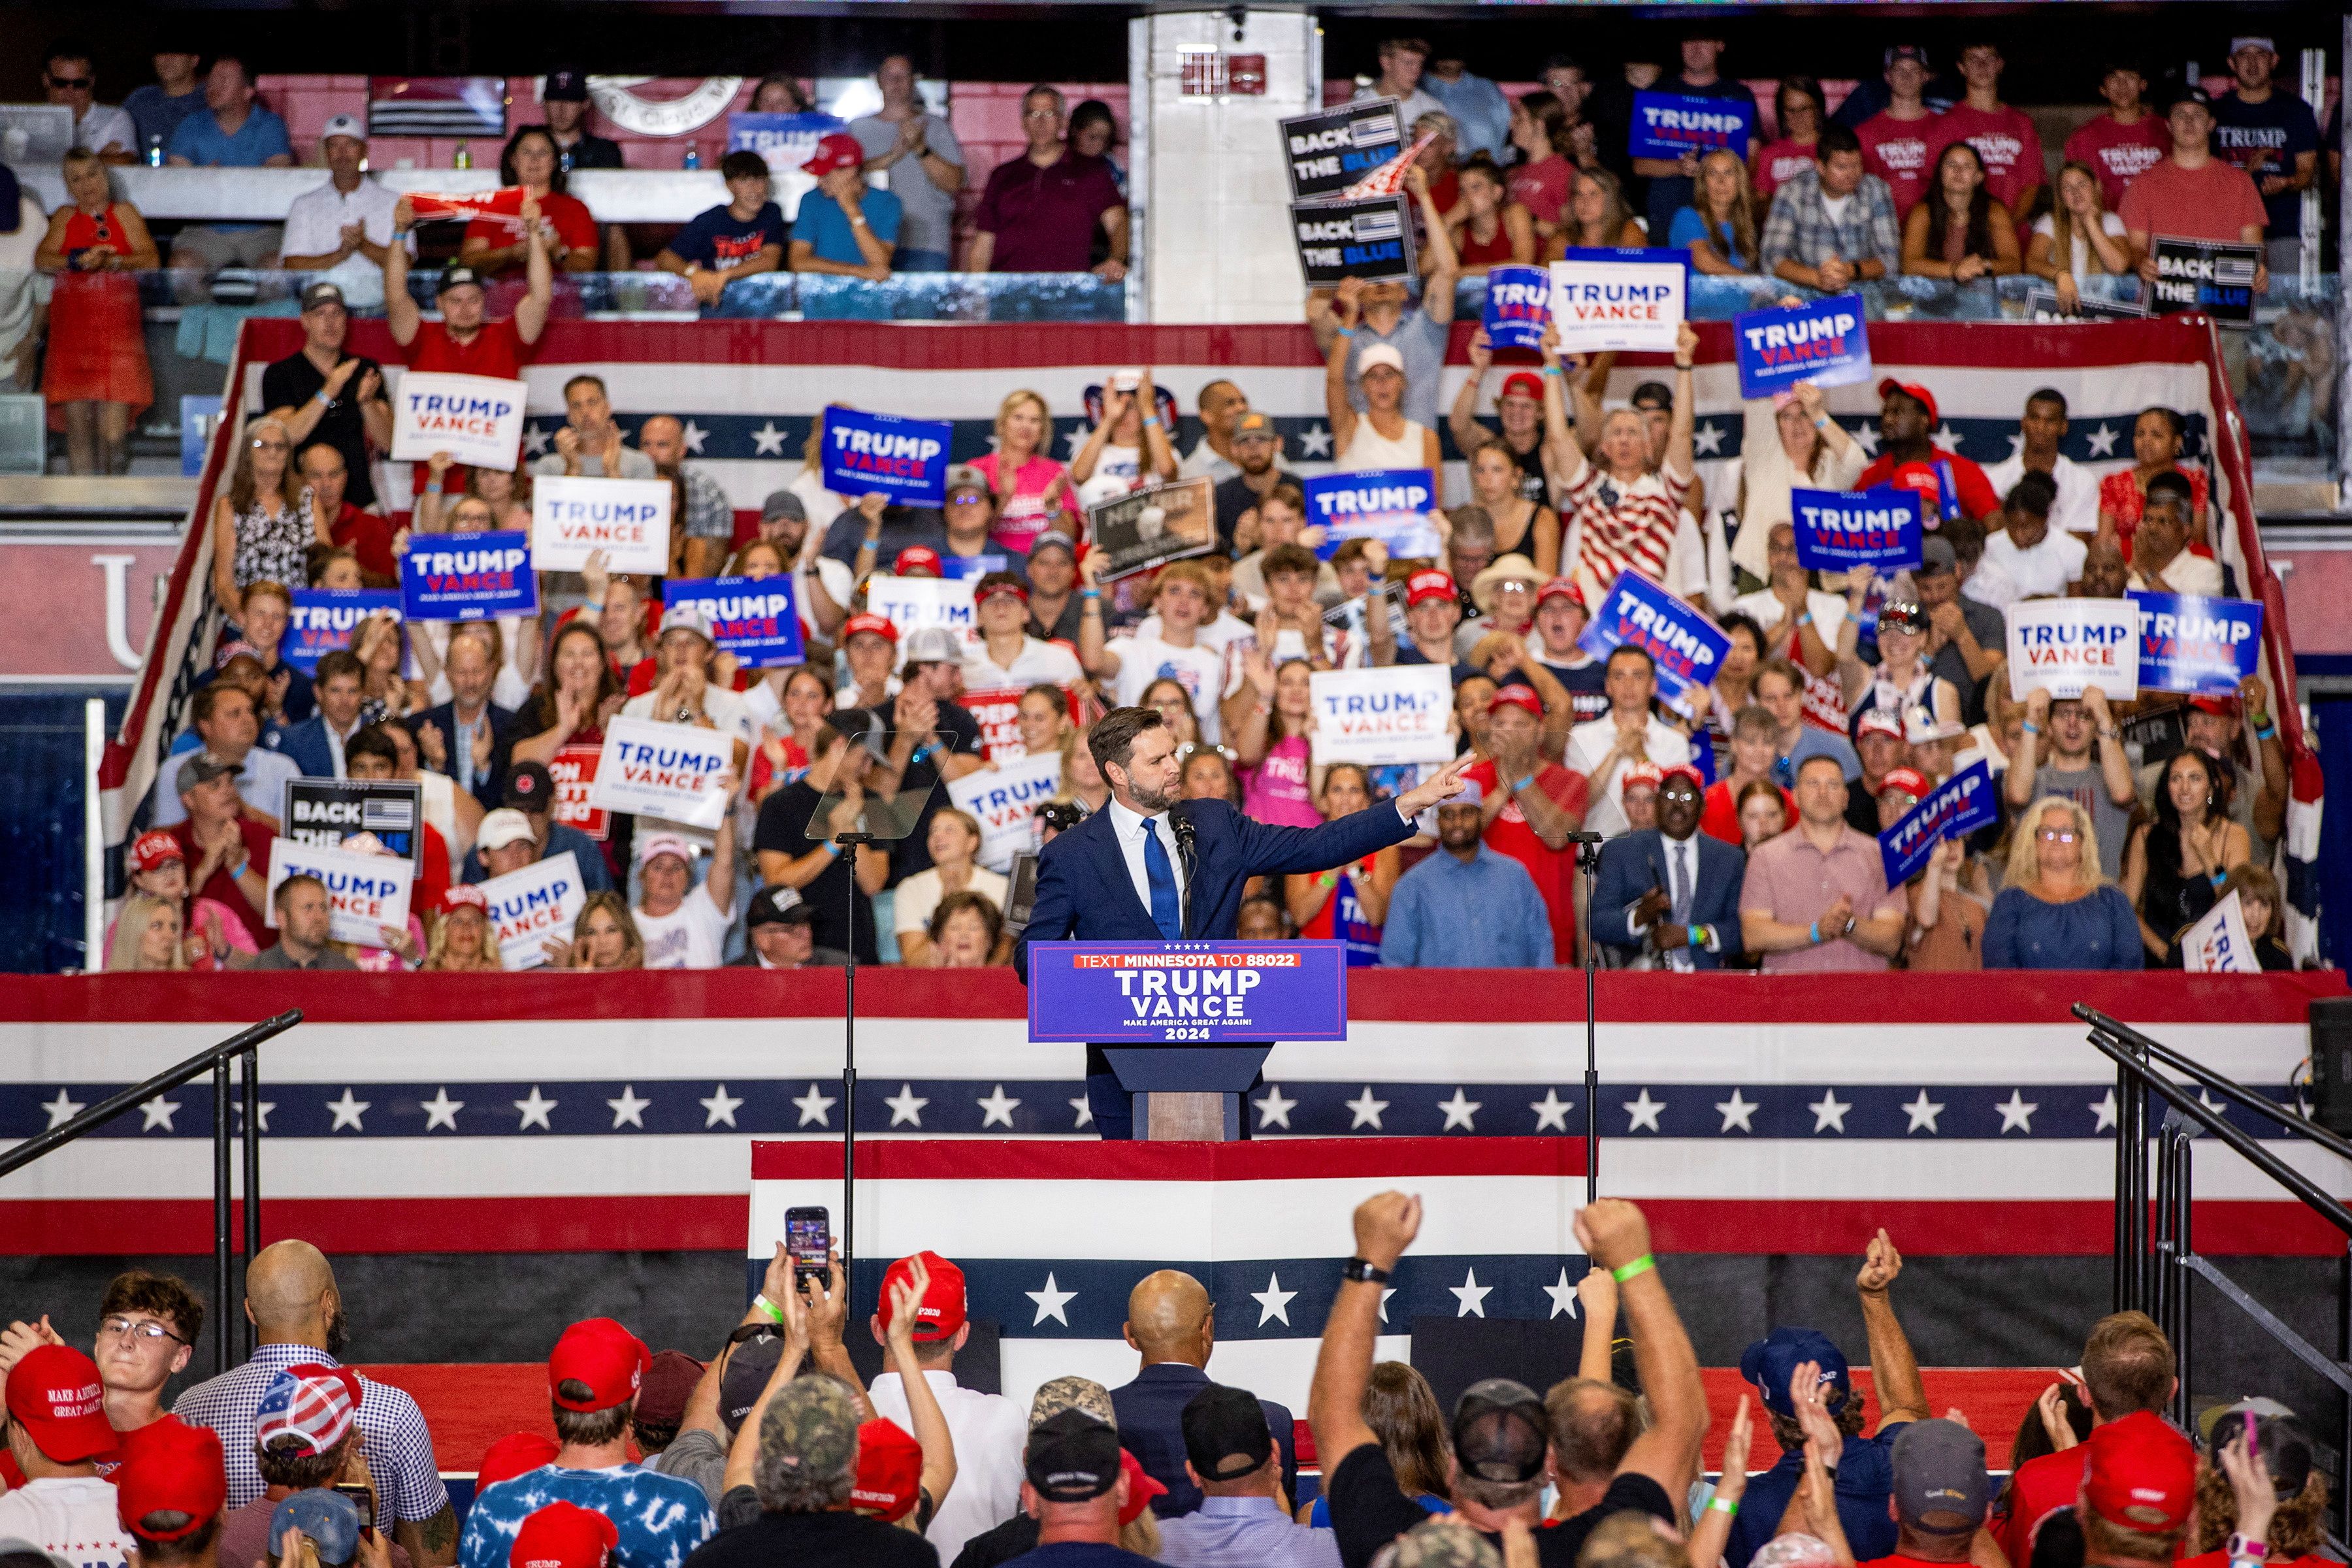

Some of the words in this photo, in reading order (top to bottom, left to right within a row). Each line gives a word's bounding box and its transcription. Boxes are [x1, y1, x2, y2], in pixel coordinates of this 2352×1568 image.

[1642, 106, 1744, 134] TRUMP
[1290, 127, 1352, 155] BACK
[2216, 126, 2287, 148] TRUMP
[1294, 155, 1343, 181] THE
[1342, 145, 1399, 172] BLUE
[1298, 220, 1354, 242] BACK
[1302, 247, 1344, 267] THE
[1343, 241, 1405, 266] BLUE
[2157, 255, 2214, 280] BACK
[1493, 284, 1549, 306] TRU
[1561, 283, 1671, 302] TRUMP
[2155, 281, 2196, 304] THE
[2198, 285, 2249, 307] BLUE
[1575, 303, 1661, 320] VANCE
[1744, 313, 1856, 351] TRUMP
[1761, 336, 1845, 367] VANCE
[409, 392, 512, 419] TRUMP
[416, 414, 497, 436] VANCE
[832, 425, 941, 461] TRUMP
[843, 450, 926, 480] VANCE
[547, 500, 657, 524] TRUMP
[1315, 487, 1428, 516] TRUMP
[560, 523, 645, 542] VANCE
[1801, 507, 1912, 534] TRUMP
[1816, 529, 1899, 549] VANCE
[410, 548, 527, 576] TRUMP
[426, 571, 514, 592] VANCE
[883, 602, 970, 625] TRUM
[302, 630, 351, 647] VAN
[713, 617, 779, 639] ANCE
[1617, 590, 1712, 665] TRUMP
[2019, 623, 2127, 647] TRUMP
[2135, 611, 2247, 644] TRUMP
[1618, 615, 1695, 678] VANCE
[2028, 647, 2117, 666] VANCE
[2146, 635, 2235, 663] VANCE
[1325, 691, 1439, 715] TRUMP
[1571, 694, 1610, 712] UMP
[1338, 713, 1429, 735] VANCE
[617, 742, 722, 773] TRUMP
[625, 766, 702, 792] VANCE
[969, 777, 1054, 815] TRUM
[293, 798, 363, 825] BACK
[988, 805, 1032, 827] VAN
[1888, 776, 1980, 852] TRUMP
[139, 836, 178, 860] USA
[291, 828, 342, 850] THE
[330, 895, 381, 919] NCE
[489, 881, 568, 923] RUMP
[498, 904, 564, 941] ANCE
[1080, 955, 1121, 968] TEXT
[1124, 955, 1217, 968] MINNESOTA
[1220, 955, 1242, 967] TO
[1246, 954, 1295, 967] 88022
[1114, 970, 1261, 996] TRUMP
[1131, 996, 1245, 1018] VANCE
[1165, 1028, 1211, 1040] 2024
[917, 1307, 941, 1317] P2020
[1818, 1371, 1837, 1383] UMP
[47, 1388, 74, 1403] MAKE
[54, 1405, 82, 1418] GREAT
[732, 1406, 752, 1418] SEMP
[850, 1489, 896, 1503] RUMP2020
[525, 1560, 563, 1568] TRUMP
